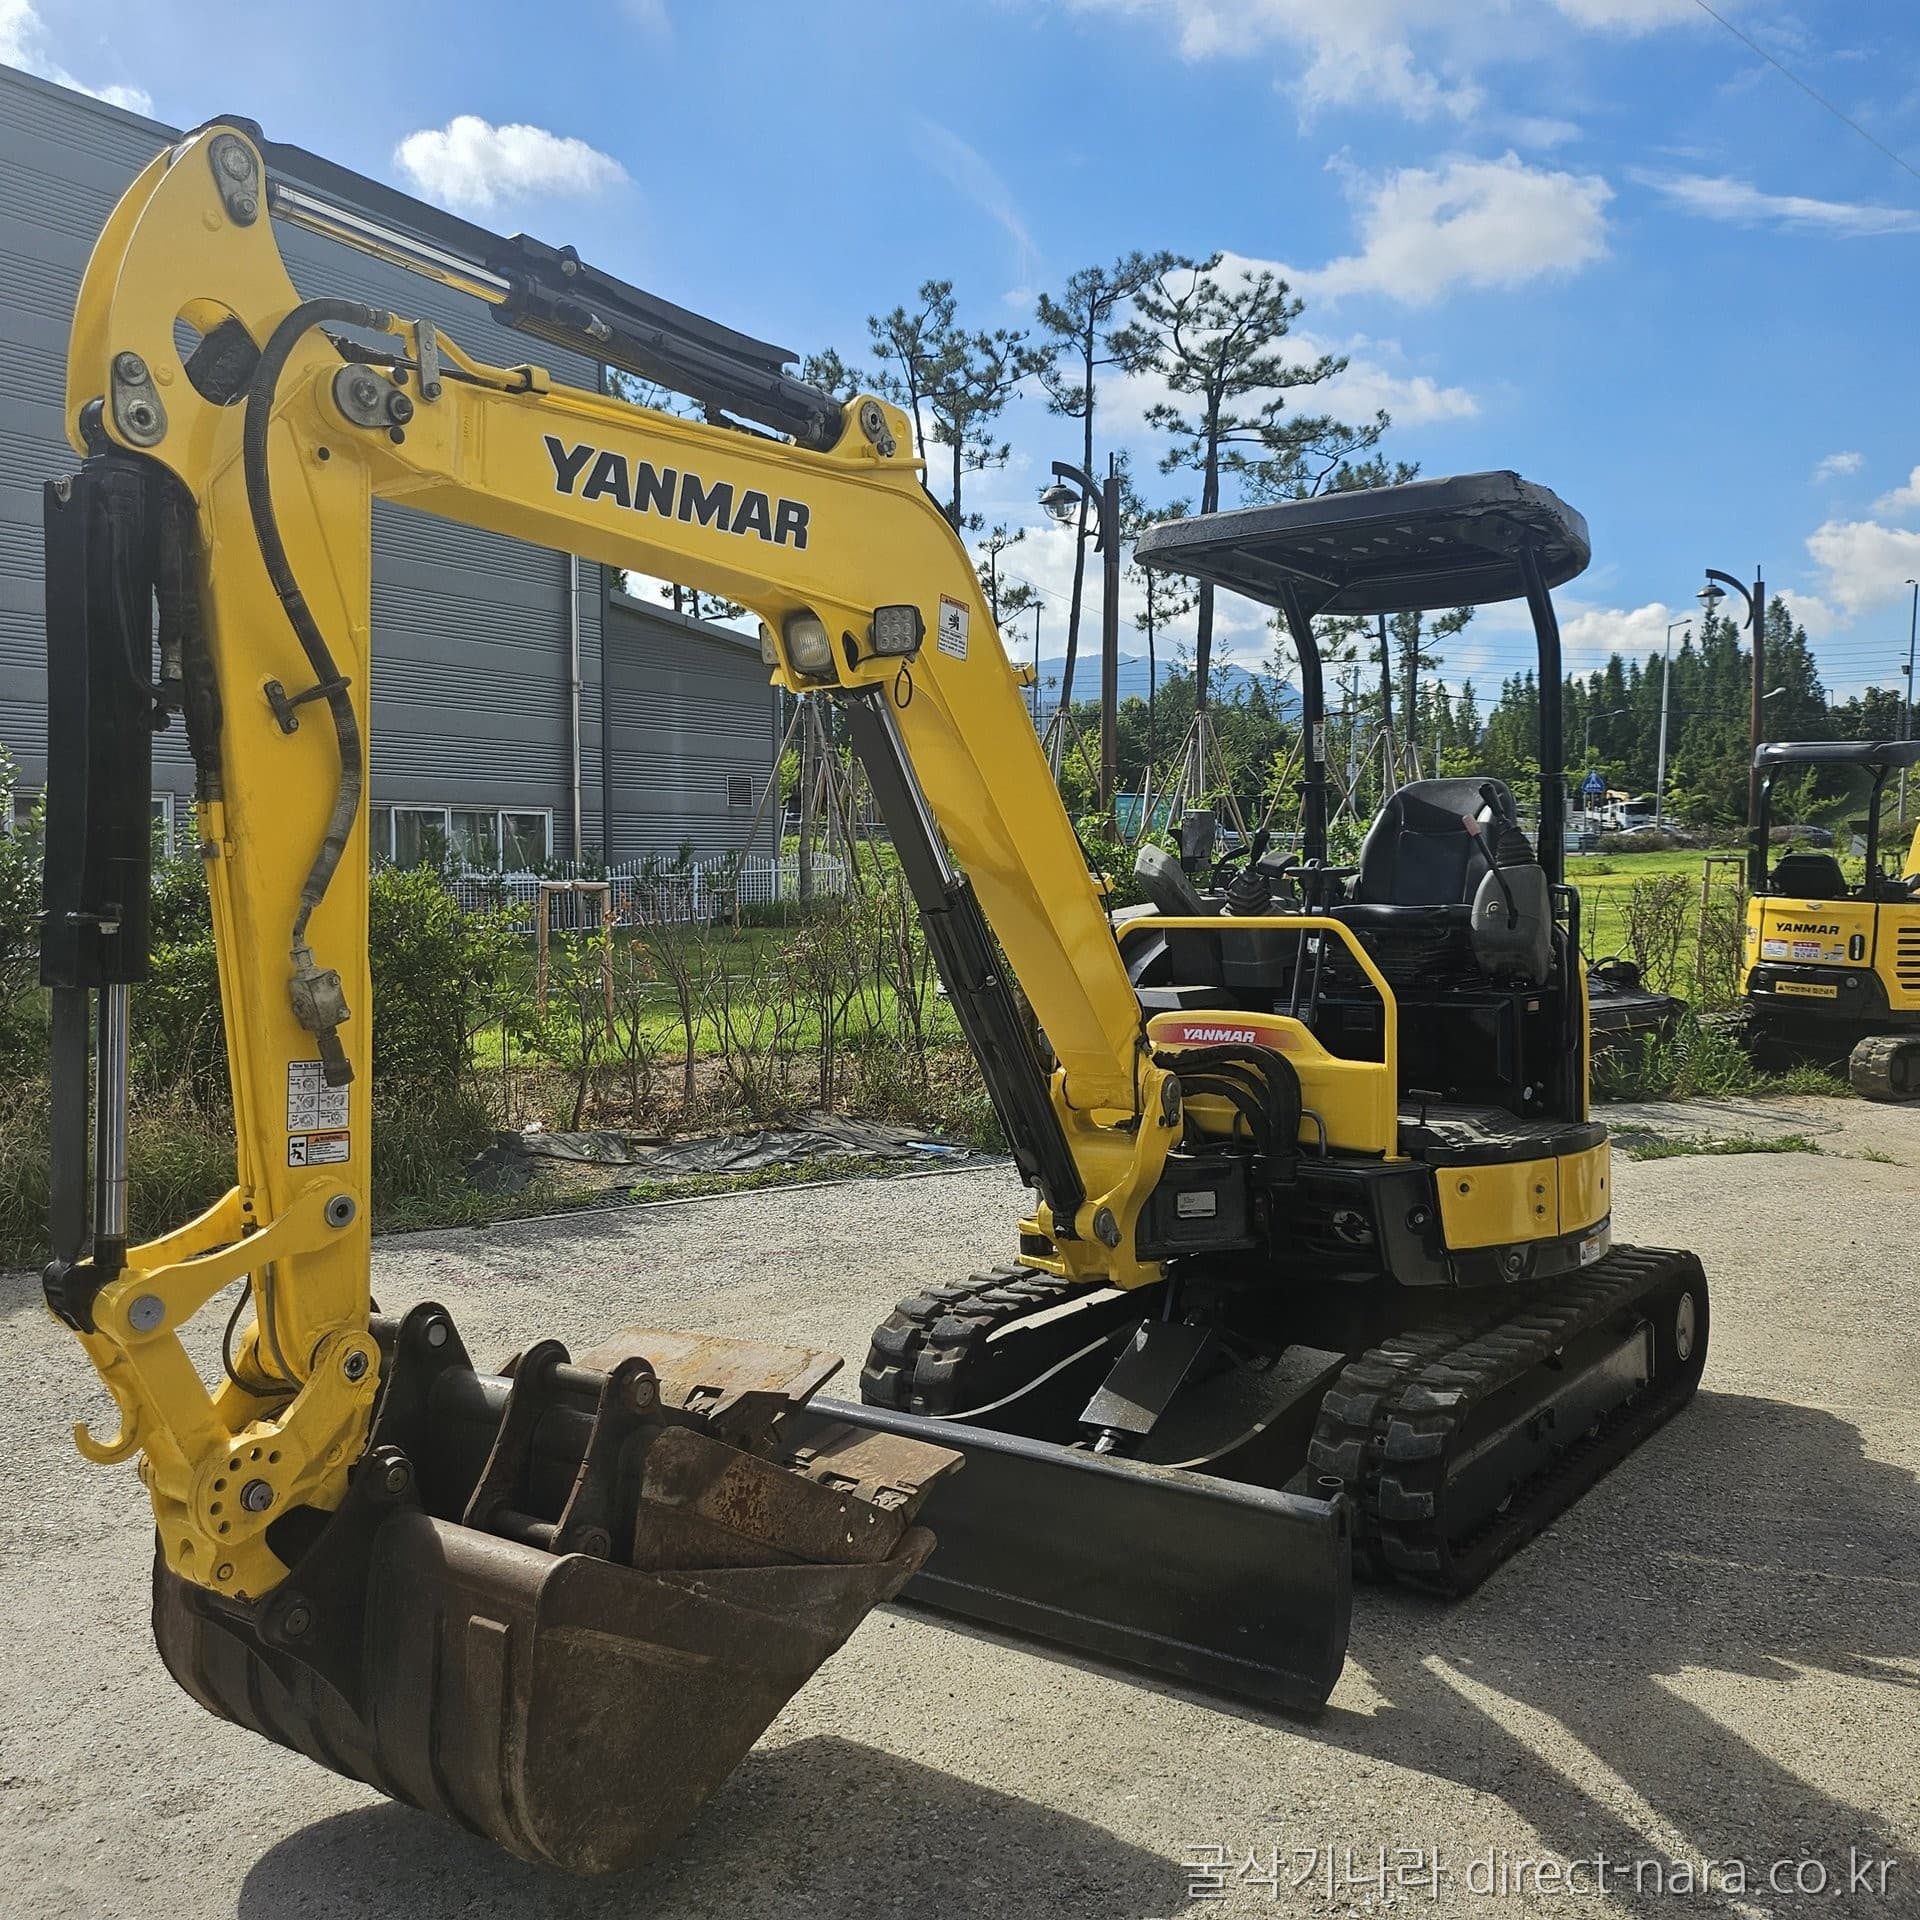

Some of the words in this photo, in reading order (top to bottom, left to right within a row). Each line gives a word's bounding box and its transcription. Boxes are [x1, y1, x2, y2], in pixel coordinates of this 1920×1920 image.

[543, 434, 811, 550] YANMAR
[1776, 922, 1840, 935] YANMAR
[1183, 1028, 1256, 1043] YANMAR
